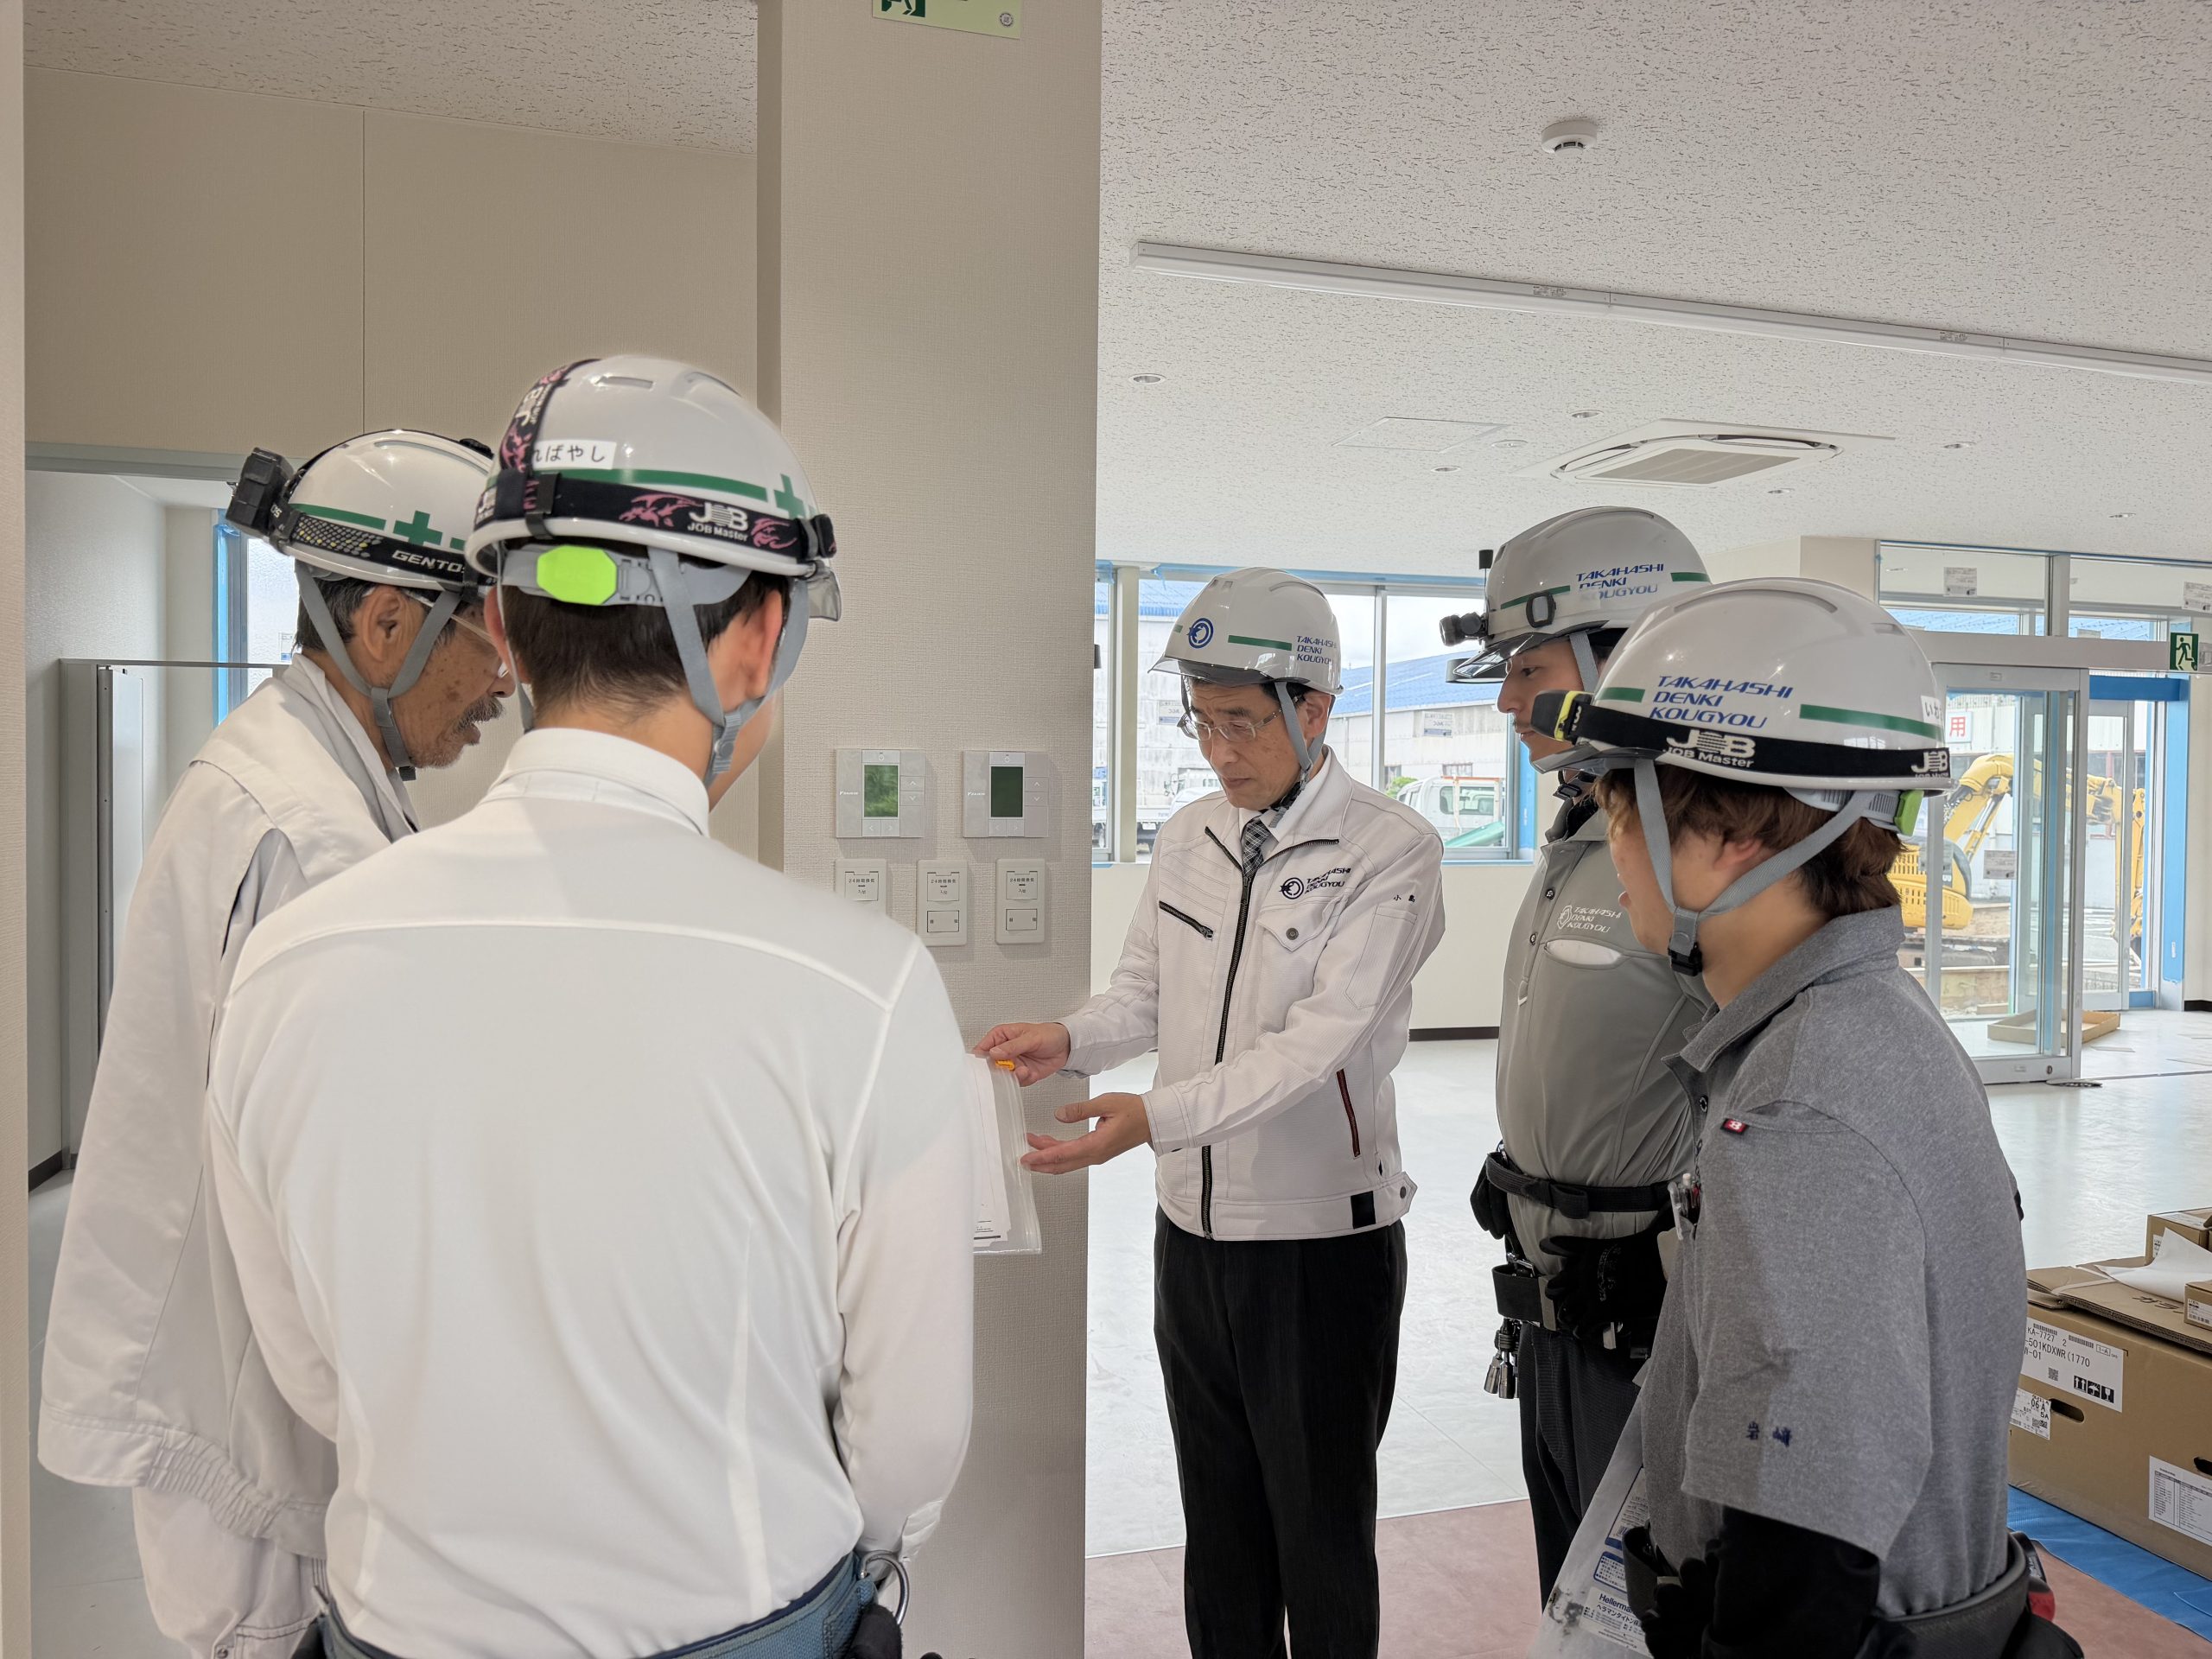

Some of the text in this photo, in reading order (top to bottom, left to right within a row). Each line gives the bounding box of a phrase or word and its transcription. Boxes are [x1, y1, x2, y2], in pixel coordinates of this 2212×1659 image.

[687, 522, 748, 542] JOB Master
[1576, 563, 1664, 582] TAKAHASHI
[1297, 645, 1322, 654] DENKI
[1657, 676, 1794, 699] TAKAHASHI
[1653, 691, 1724, 707] DENKI
[1649, 707, 1768, 729] KOUGYOU
[1949, 716, 1967, 737] 用
[1698, 753, 1755, 768] Master
[2063, 1338, 2067, 1347] 2
